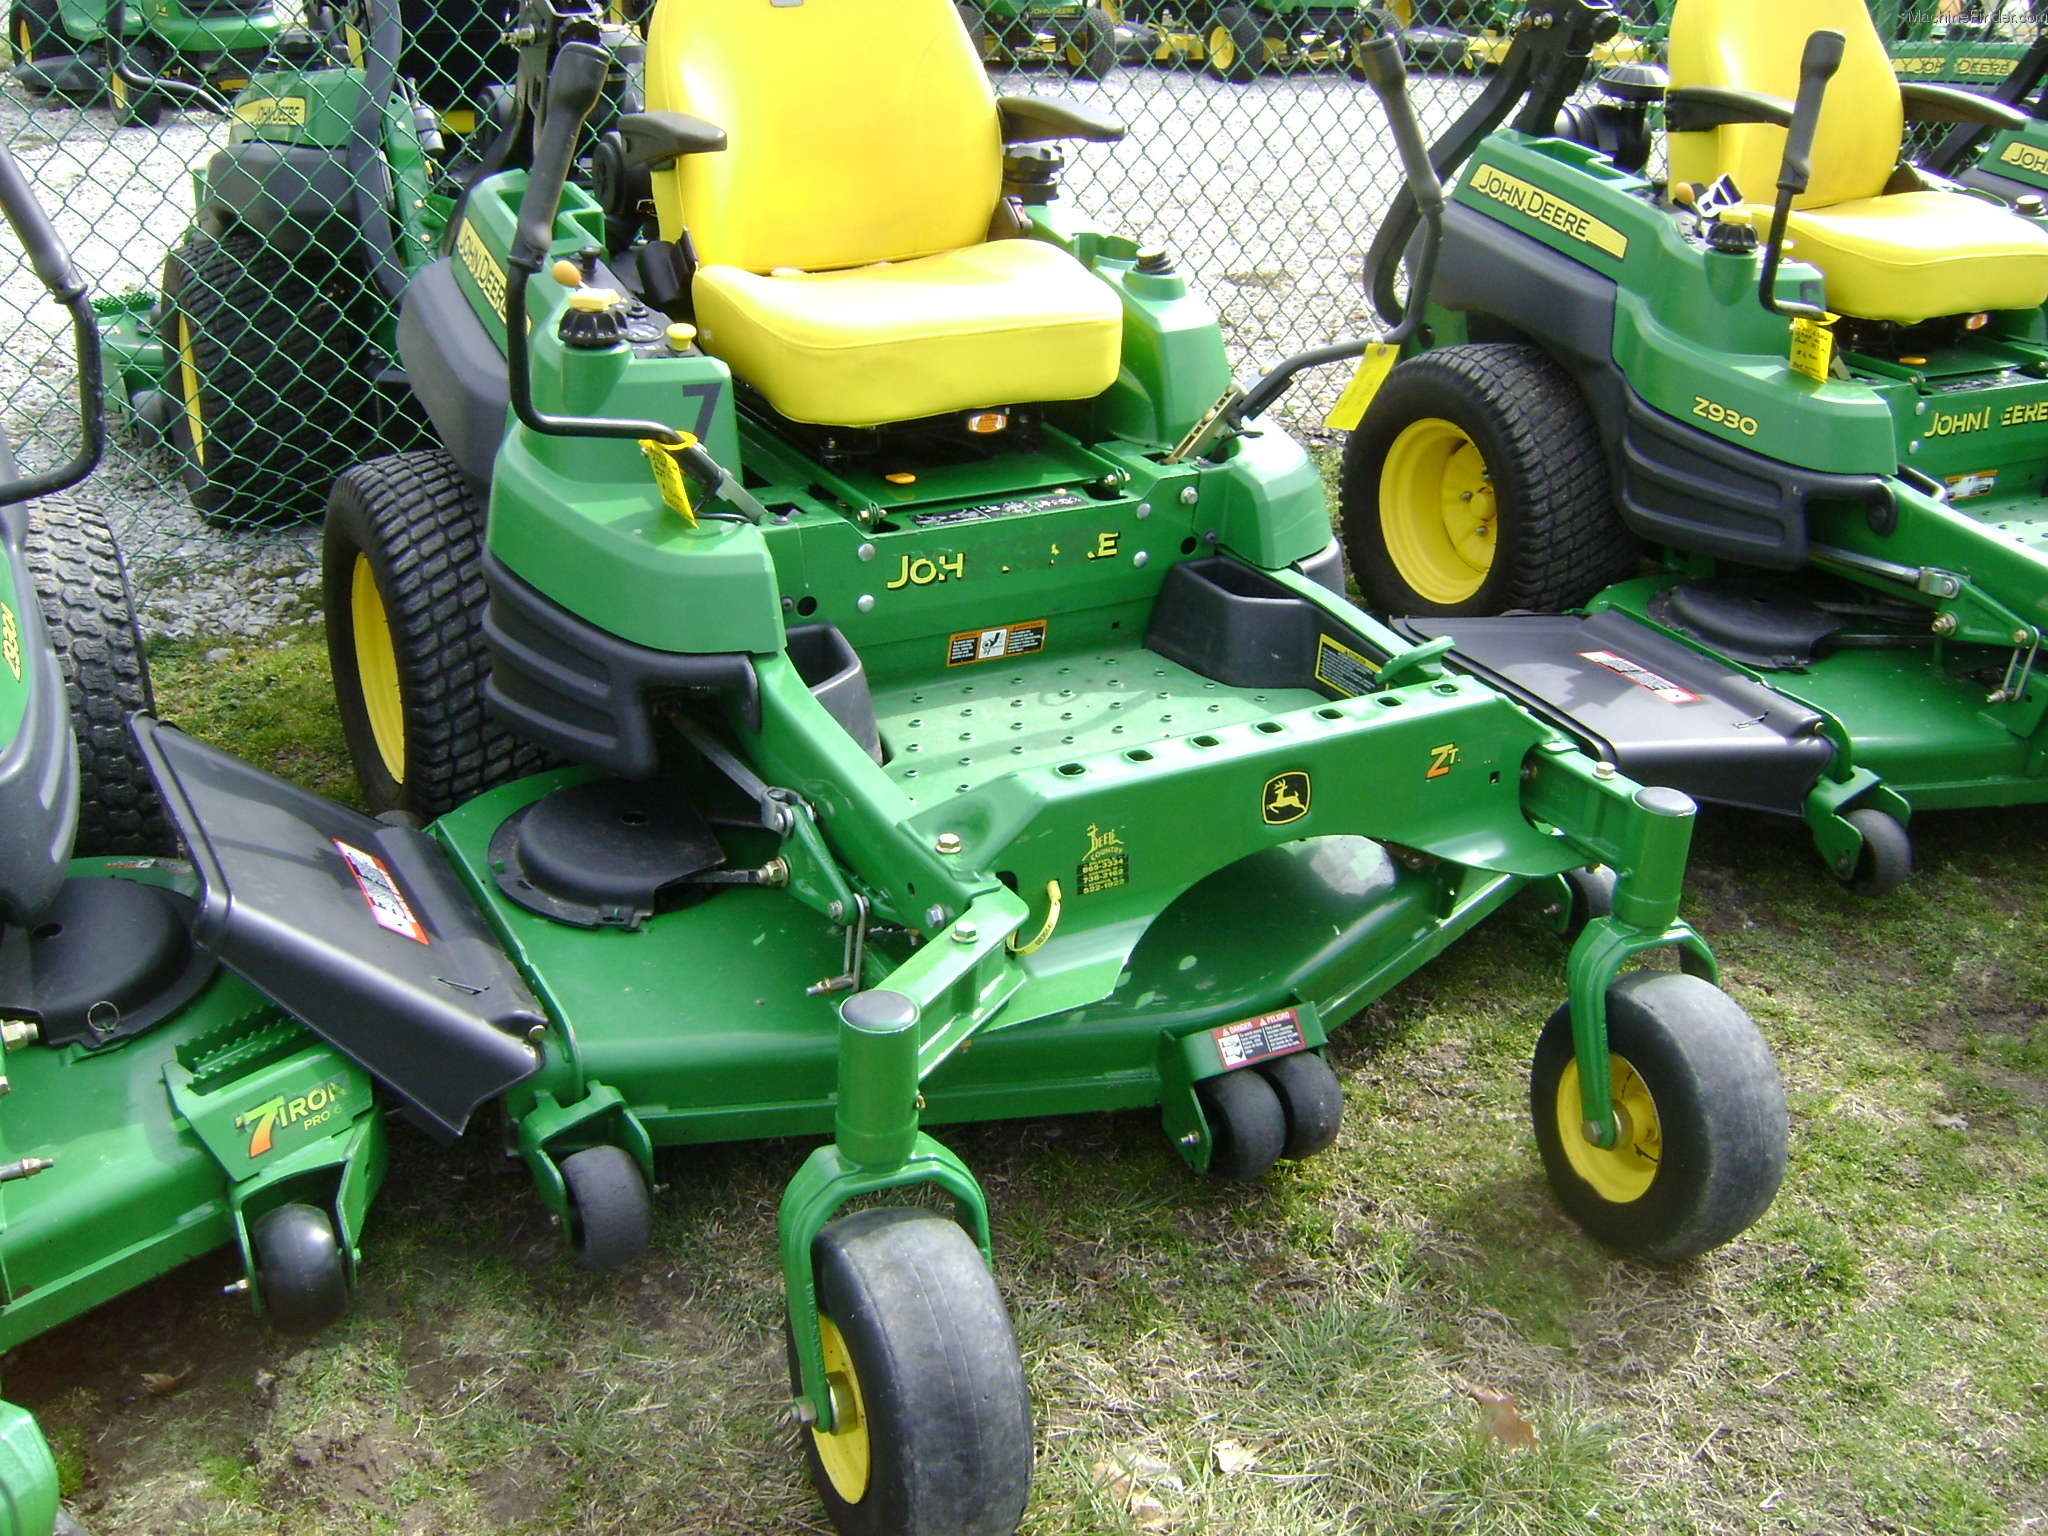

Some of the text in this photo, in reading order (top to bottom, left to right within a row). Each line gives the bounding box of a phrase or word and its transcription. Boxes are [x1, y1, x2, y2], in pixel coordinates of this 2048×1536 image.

[1957, 60, 2009, 75] DEERE
[2010, 147, 2048, 171] JOH
[1479, 171, 1591, 238] JOHN DEERE
[459, 226, 507, 316] JOHN DEER
[1692, 395, 1759, 436] Z930
[1924, 411, 1982, 437] JOHN
[303, 1110, 331, 1131] PRO
